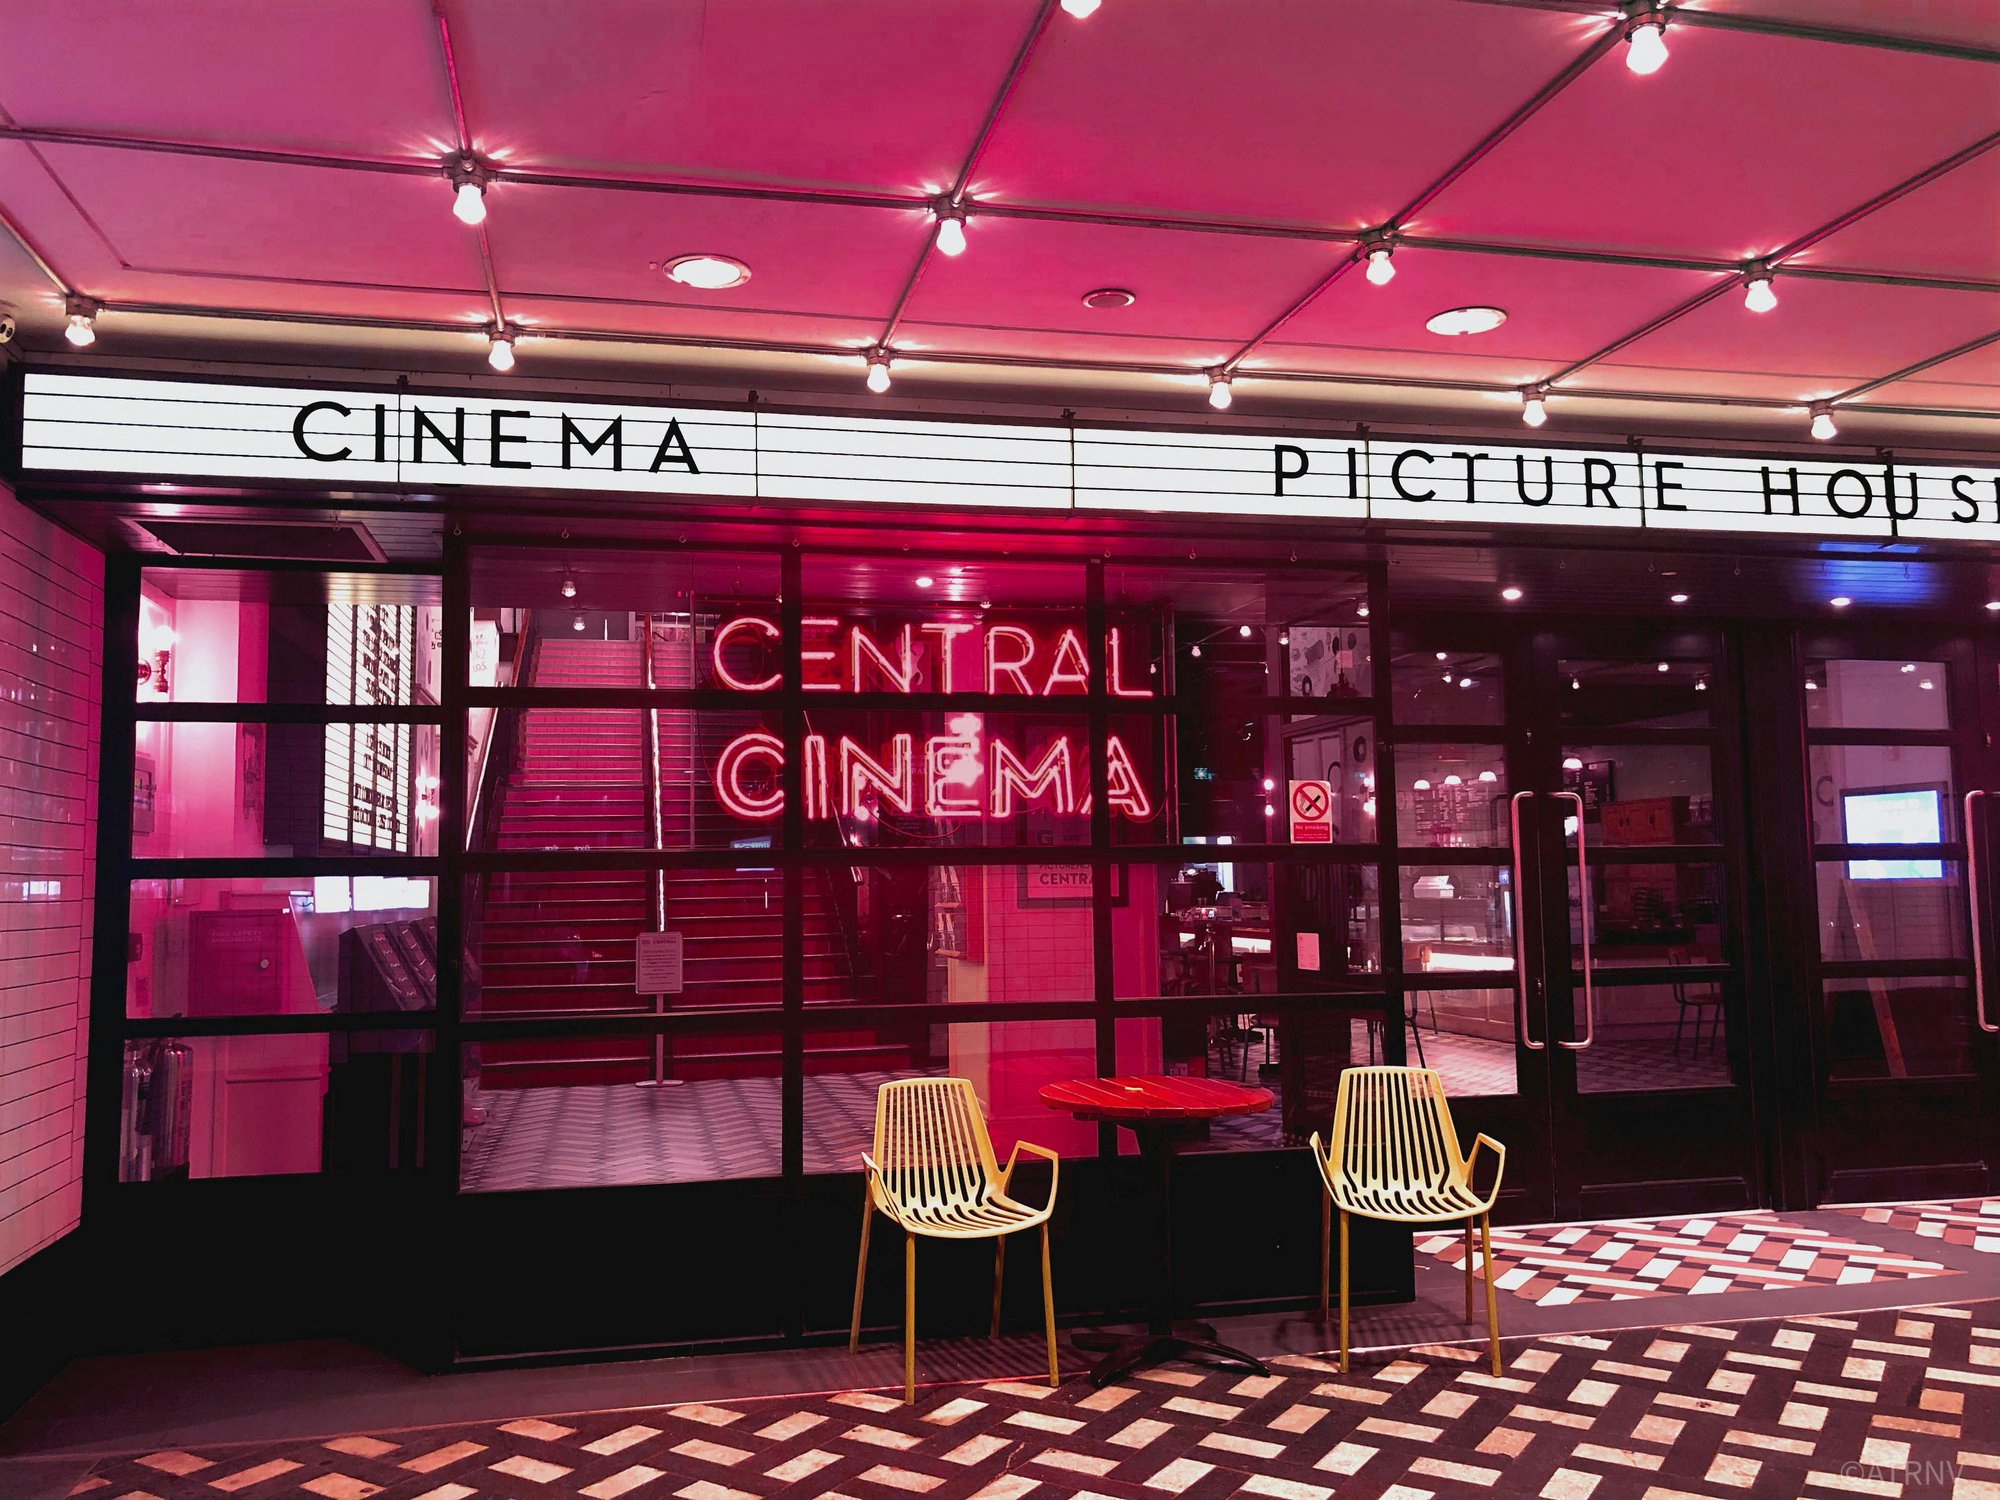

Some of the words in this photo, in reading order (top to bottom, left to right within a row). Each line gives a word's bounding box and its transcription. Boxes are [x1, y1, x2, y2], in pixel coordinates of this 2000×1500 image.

[292, 400, 700, 474] CINEMA
[1274, 444, 1687, 512] PICTURE
[1761, 466, 2000, 524] HOUS
[713, 616, 1154, 696] CENTRAL
[716, 732, 1150, 819] CINEMA
[1039, 873, 1092, 885] CENTR
